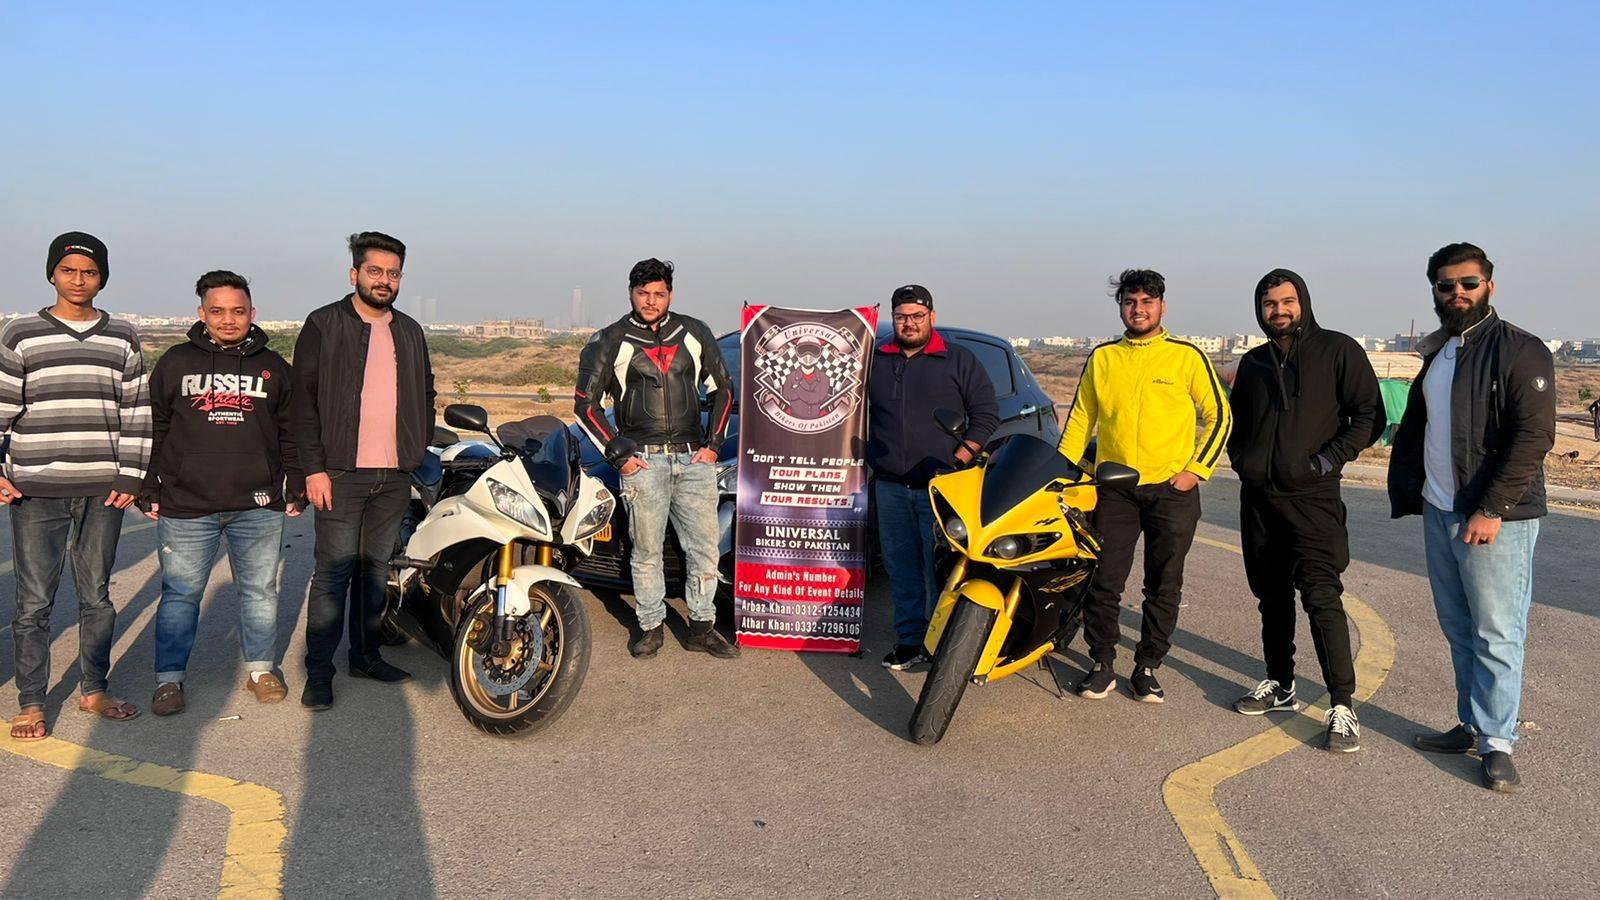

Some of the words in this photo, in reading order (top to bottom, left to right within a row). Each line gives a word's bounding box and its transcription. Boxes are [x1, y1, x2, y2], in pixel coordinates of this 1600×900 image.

[784, 327, 836, 341] Universal
[182, 373, 267, 398] RUSSELL
[790, 456, 816, 466] TELL
[821, 458, 864, 467] PEOPLE
[772, 469, 800, 478] YOUR
[773, 482, 806, 491] SHOW
[811, 484, 841, 493] THEM
[764, 494, 792, 503] YOUR
[765, 525, 840, 541] UNIVERSAL
[755, 538, 786, 548] BIKERS
[788, 541, 801, 549] OF
[804, 541, 850, 550] PAKISTAN
[765, 569, 800, 581] Admin's
[803, 571, 837, 583] Number
[738, 581, 752, 592] For
[754, 583, 770, 596] Any
[773, 584, 792, 596] Kind
[795, 585, 805, 597] Of
[807, 586, 832, 597] Event
[834, 588, 864, 599] Details
[741, 599, 766, 613] Arbaz
[741, 616, 765, 630] Athar
